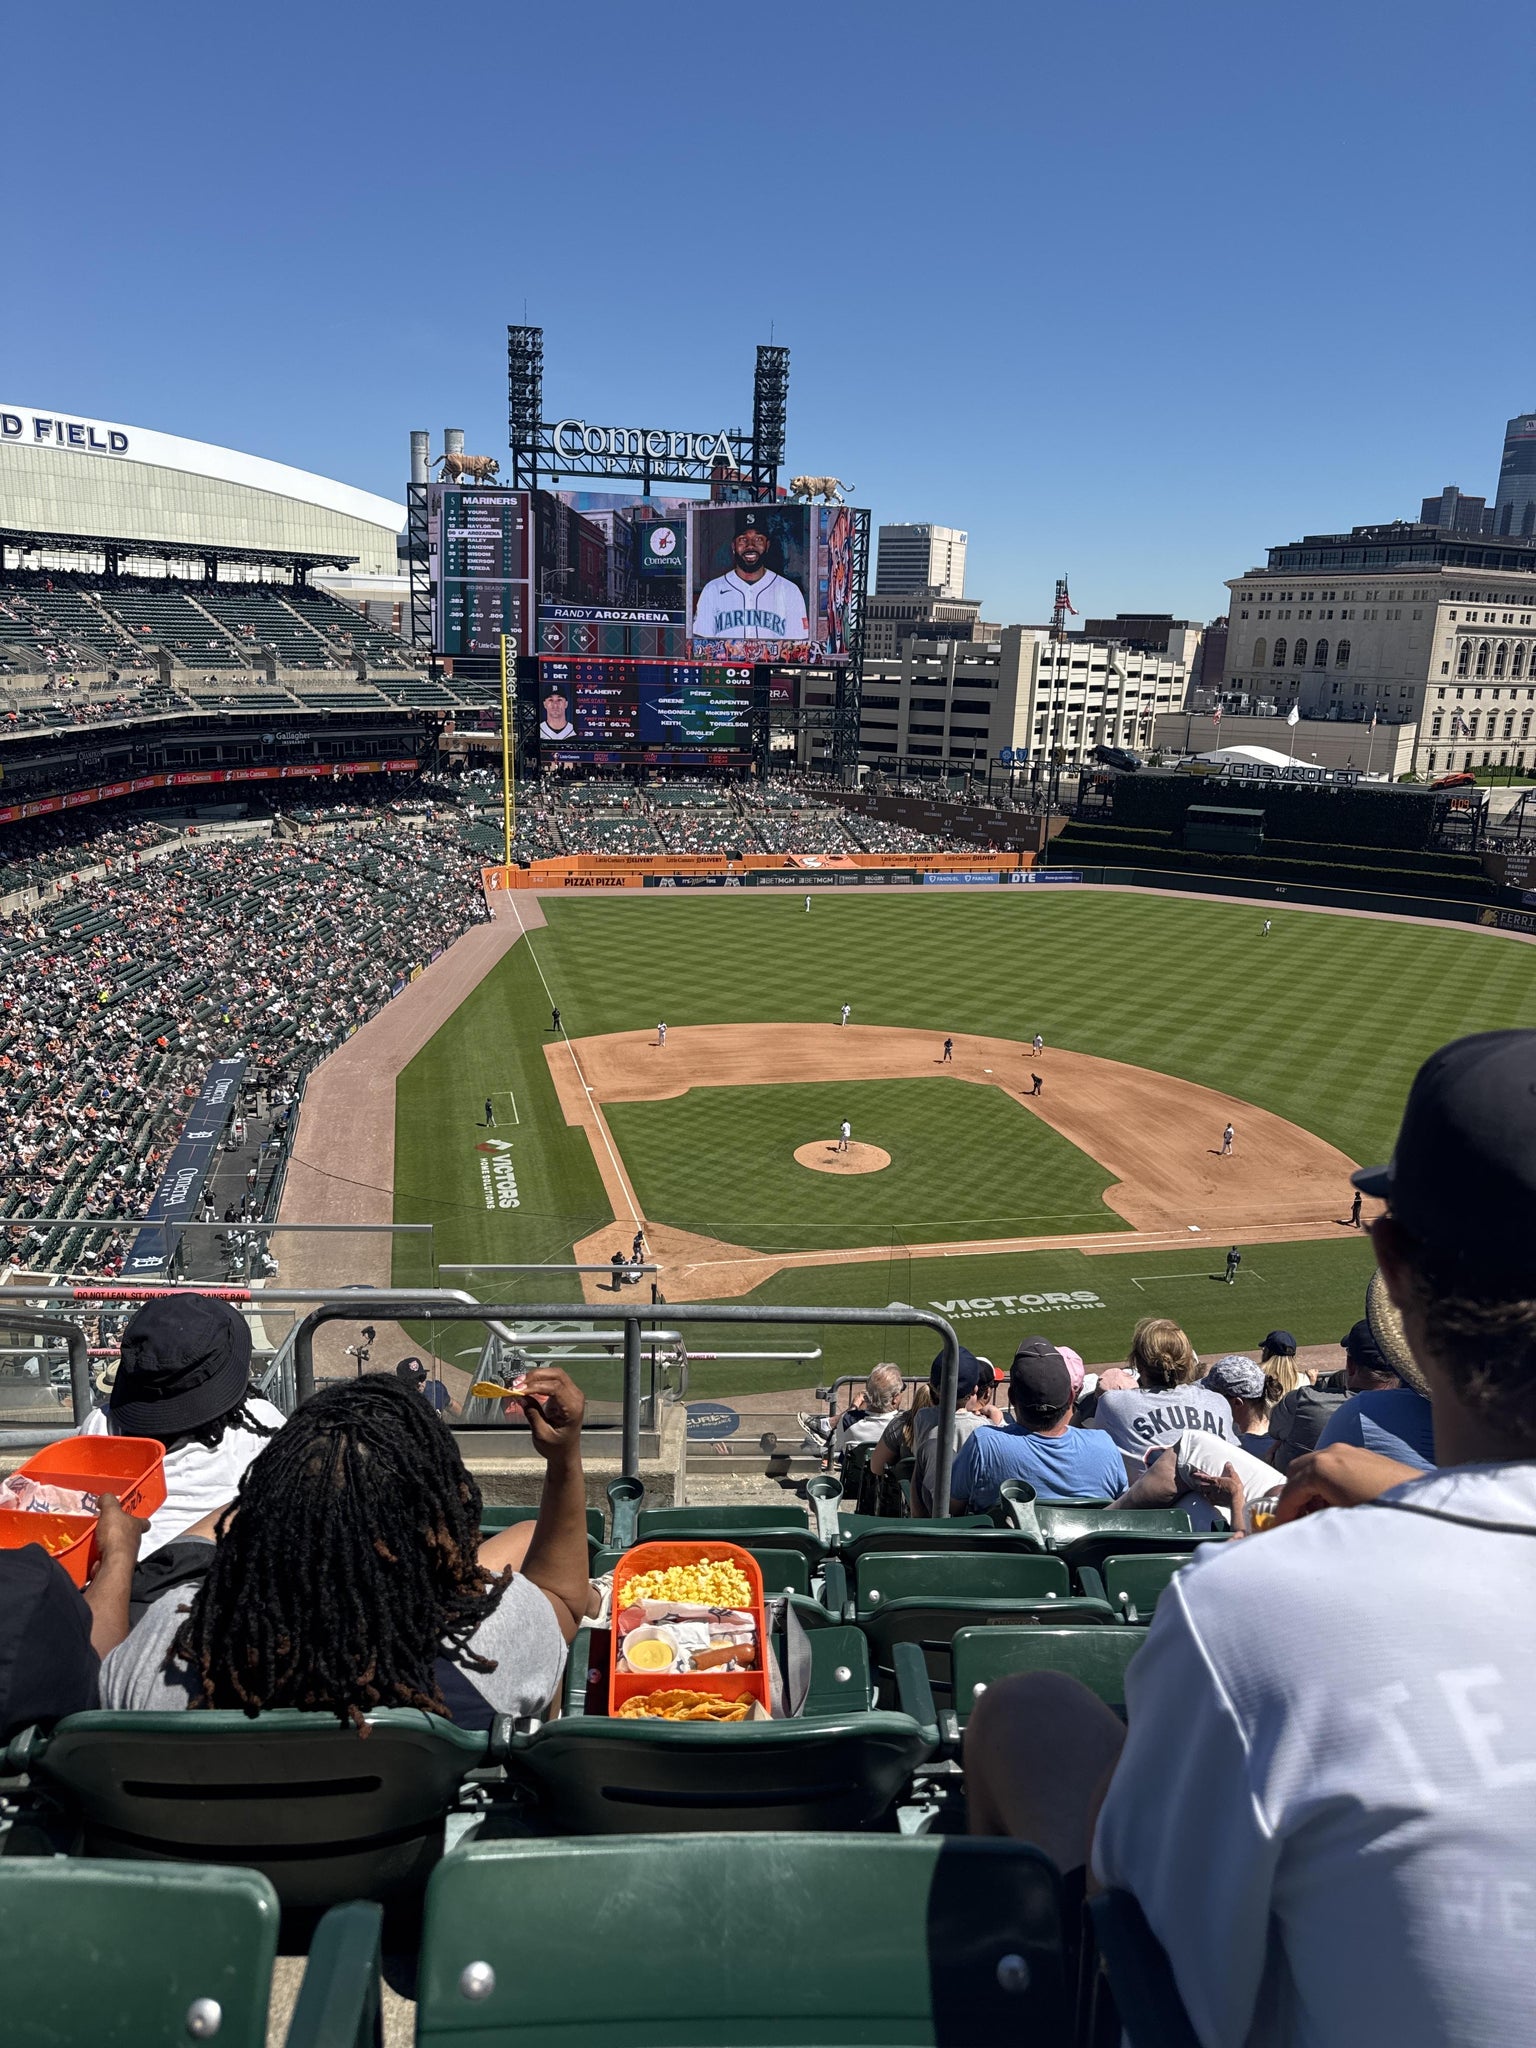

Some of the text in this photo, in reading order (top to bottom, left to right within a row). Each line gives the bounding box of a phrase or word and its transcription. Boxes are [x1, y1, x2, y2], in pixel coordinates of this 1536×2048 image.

[33, 416, 129, 456] FIELD
[606, 457, 690, 478] PARK
[462, 497, 518, 506] MARINERS
[554, 609, 670, 622] RANDY AROZARENA
[714, 609, 786, 637] MARINERS
[506, 650, 518, 699] Rocket
[276, 731, 310, 741] Gallagher
[1229, 763, 1363, 786] CHEVROLET
[1203, 778, 1338, 795] FOUNTAIN
[962, 808, 968, 816] 2
[564, 877, 625, 887] PIZZA! PIZZA!
[765, 877, 795, 885] BETMGM
[804, 877, 834, 885] BETMGM
[1011, 873, 1036, 884] DTE
[1504, 870, 1529, 879] COCHRANE
[492, 1153, 521, 1209] VICTORS
[77, 1291, 90, 1301] DO
[90, 1291, 105, 1301] NOT
[928, 1290, 1100, 1313] VICTORS
[947, 1302, 1107, 1321] HOME SOLUTIONS
[1133, 1405, 1227, 1443] SKUBAL
